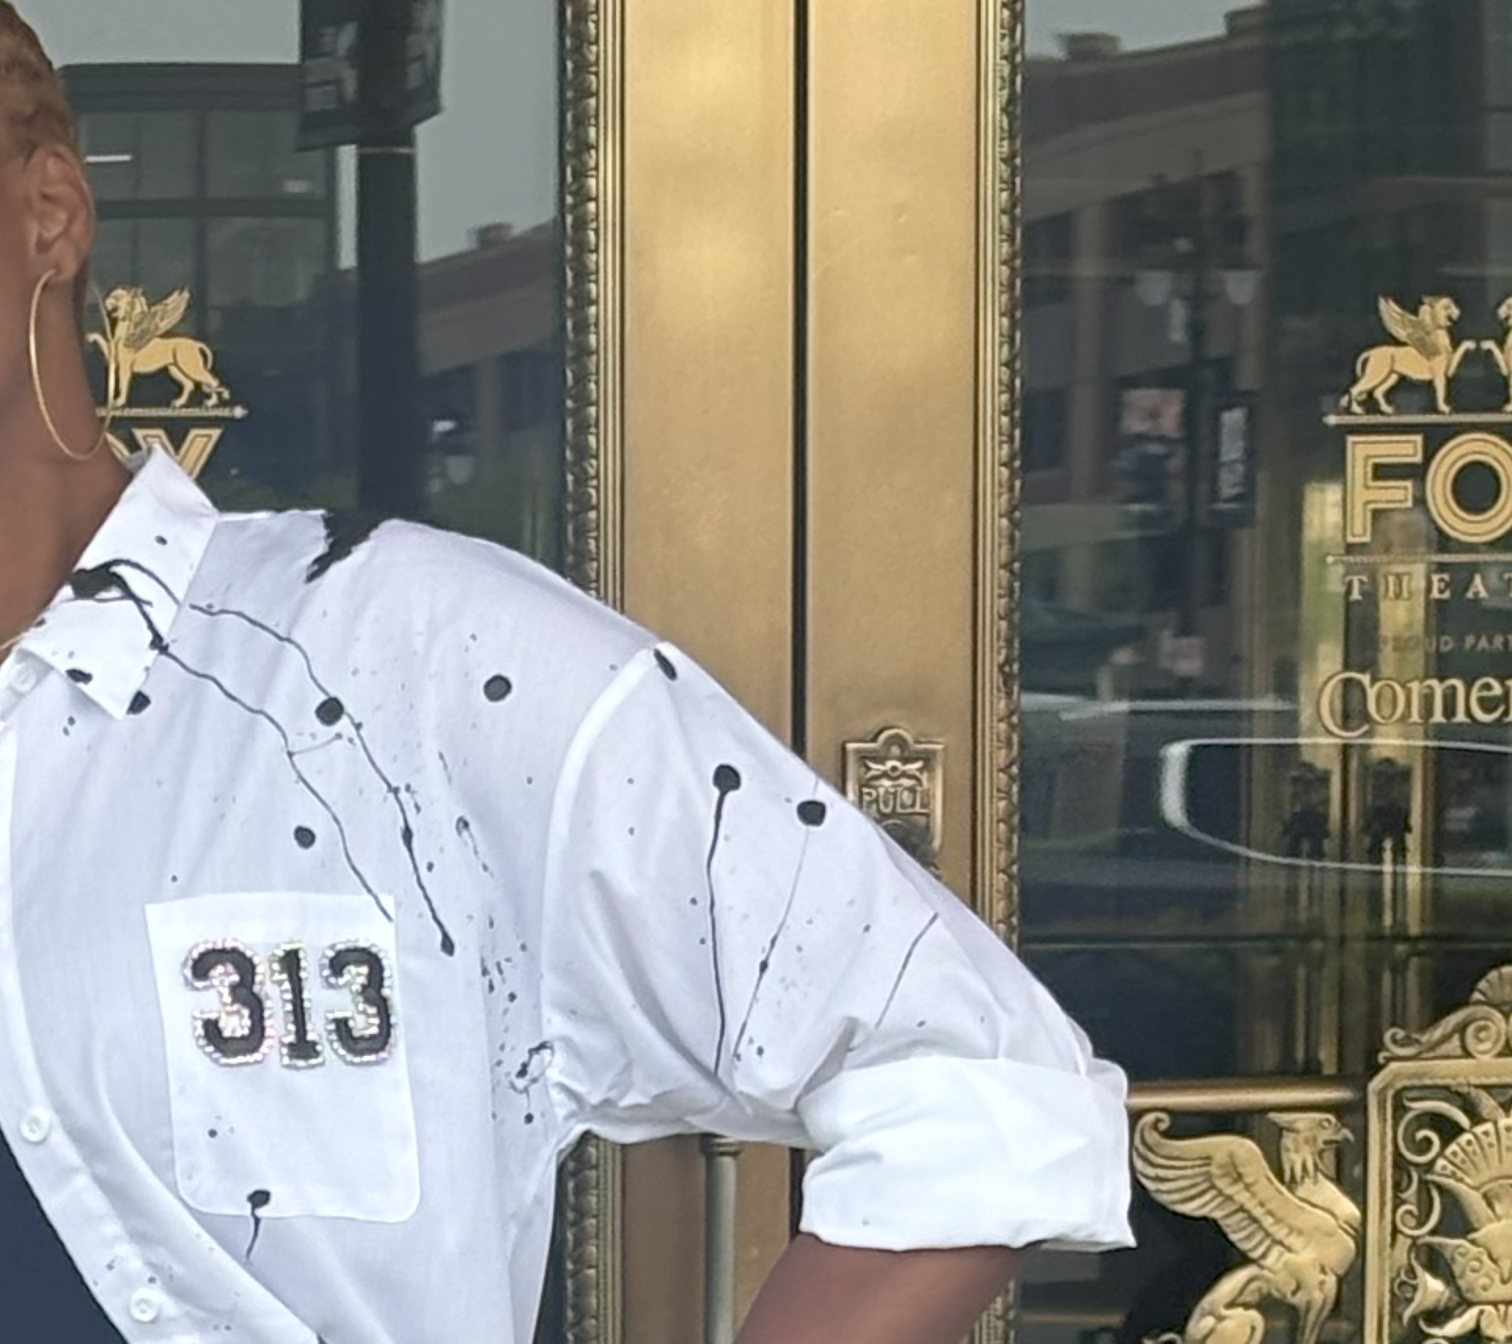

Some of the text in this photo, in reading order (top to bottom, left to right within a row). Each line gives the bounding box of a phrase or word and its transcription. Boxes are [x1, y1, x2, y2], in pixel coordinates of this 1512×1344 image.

[1464, 632, 1512, 652] PAR
[861, 786, 930, 814] PULL
[182, 938, 397, 1068] 313
